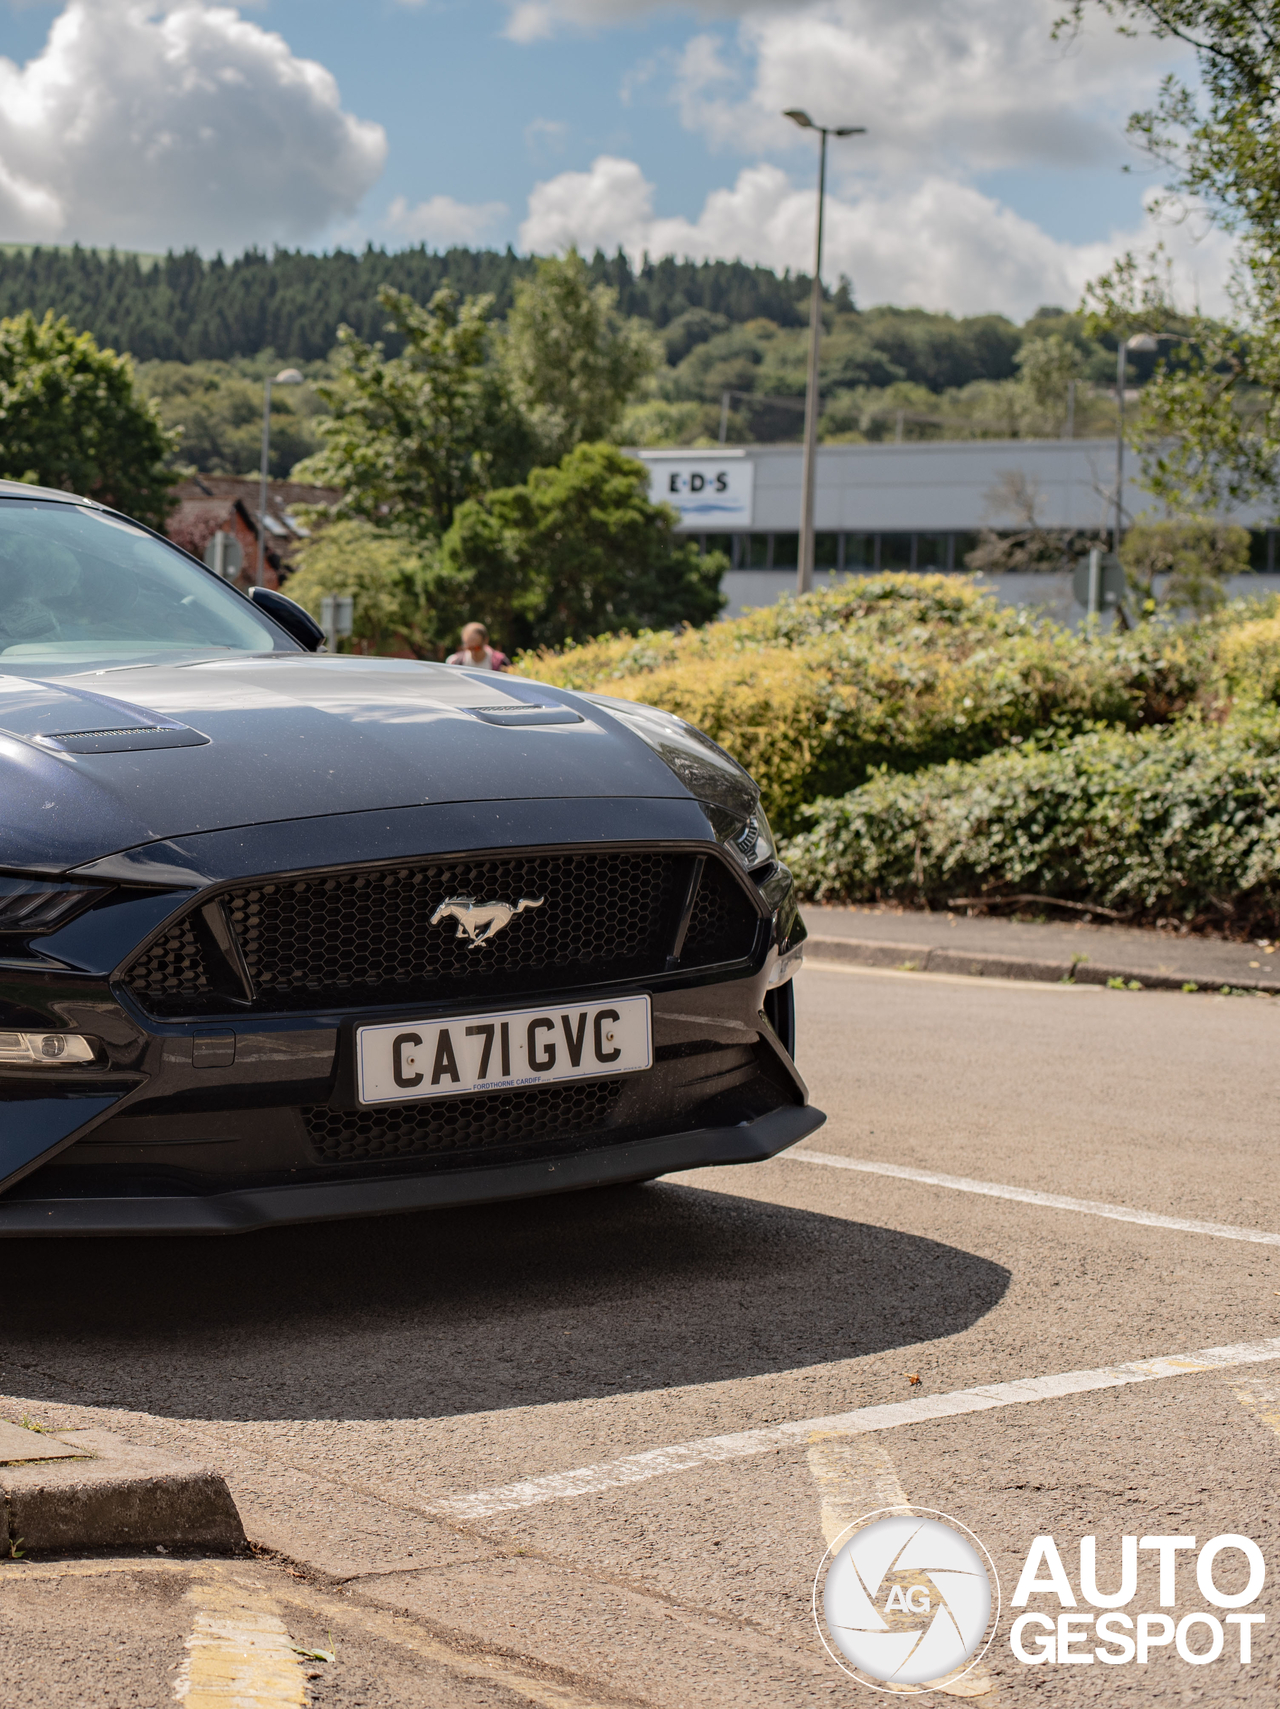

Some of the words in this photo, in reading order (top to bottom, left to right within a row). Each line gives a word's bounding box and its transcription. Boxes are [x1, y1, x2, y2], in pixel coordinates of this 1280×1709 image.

[527, 1009, 621, 1072] GVC
[472, 1079, 515, 1091] FORDTHORNE
[516, 1076, 542, 1086] CARDIFF
